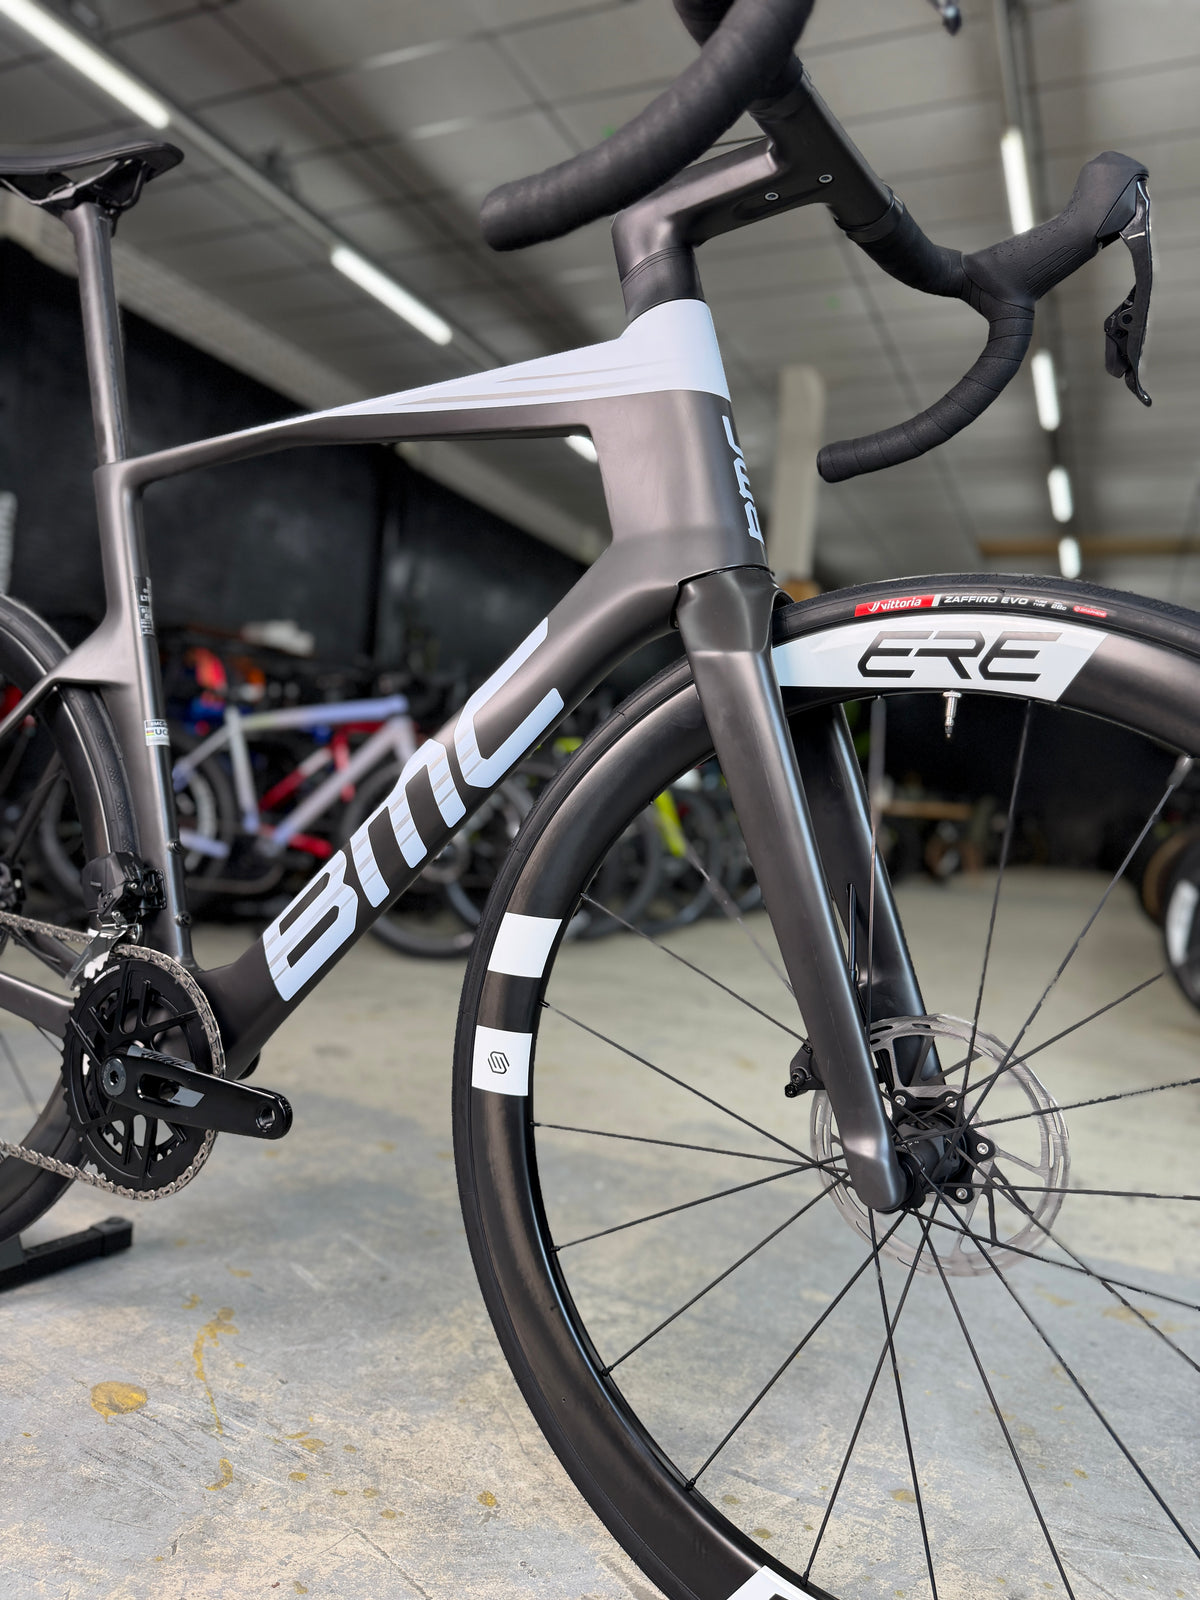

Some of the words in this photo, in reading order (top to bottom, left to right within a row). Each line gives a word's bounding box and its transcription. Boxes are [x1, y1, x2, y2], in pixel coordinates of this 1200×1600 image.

[880, 597, 922, 611] vittoria
[944, 595, 998, 604] ZAFFIRO
[1000, 596, 1029, 605] EVO
[857, 630, 1063, 682] ERE
